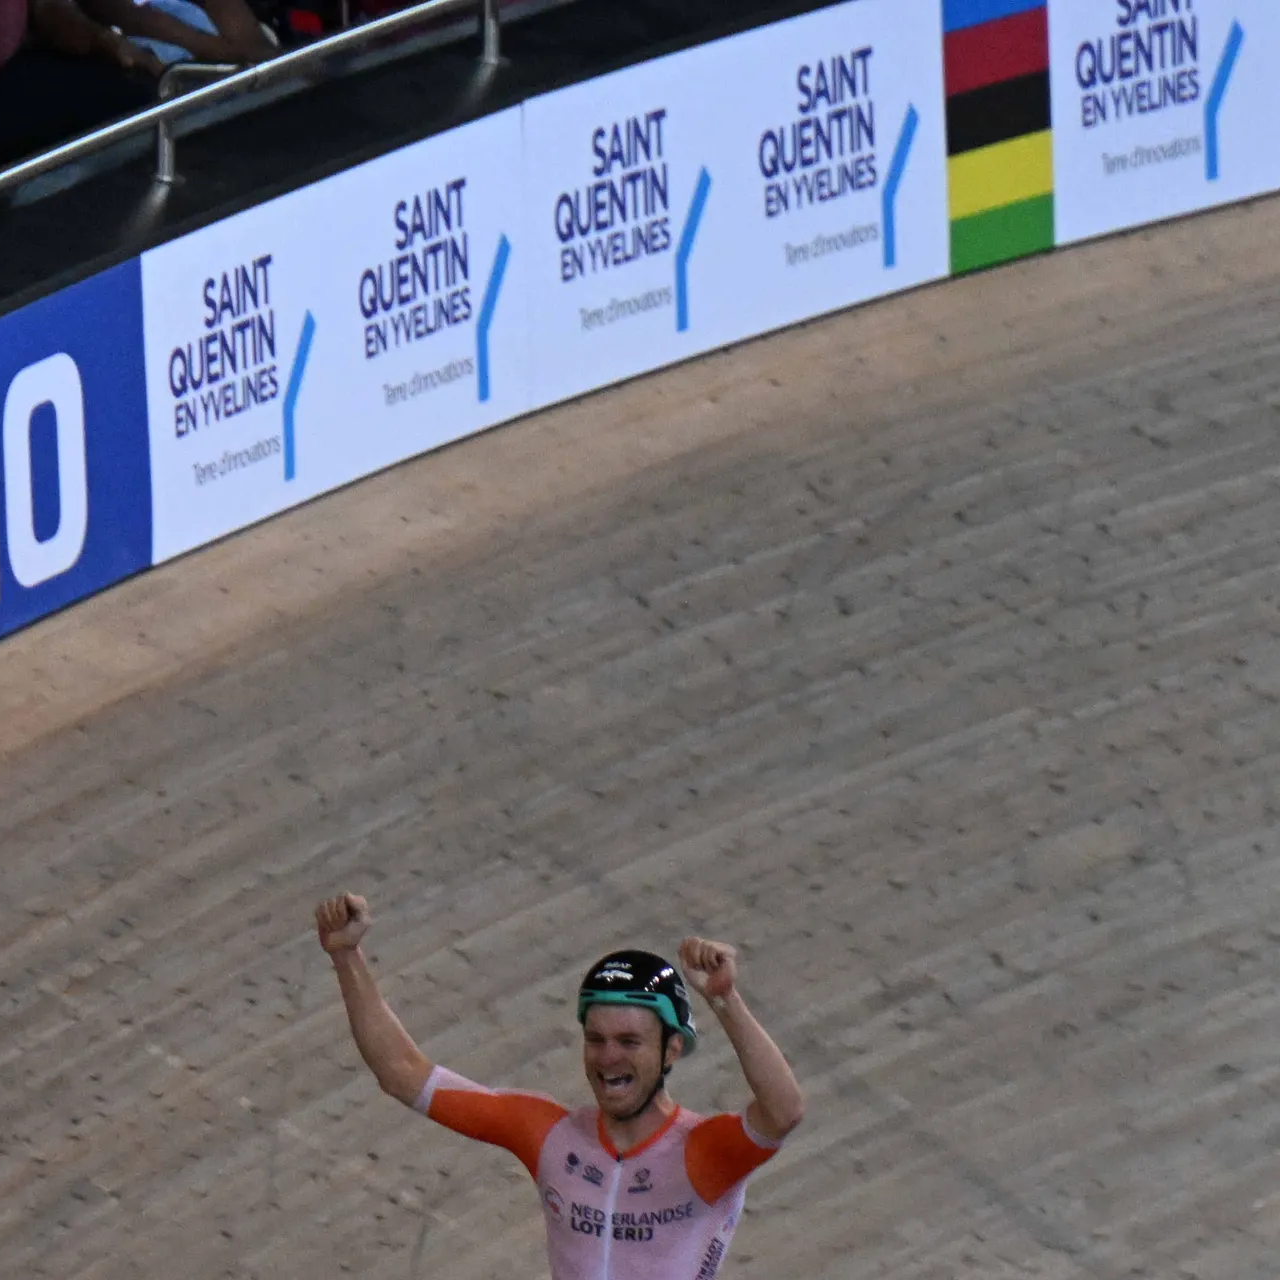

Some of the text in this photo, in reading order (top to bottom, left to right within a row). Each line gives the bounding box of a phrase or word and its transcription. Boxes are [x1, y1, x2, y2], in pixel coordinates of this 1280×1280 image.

[797, 45, 874, 114] SAINT
[1075, 15, 1198, 89] QUENTIN
[1081, 69, 1200, 128] EN YVELINES
[591, 108, 666, 177] SAINT
[759, 100, 876, 178] QUENTIN
[394, 176, 467, 250] SAINT
[555, 163, 669, 243] QUENTIN
[765, 154, 877, 219] EN YVELINES
[359, 231, 469, 319] QUENTIN
[561, 217, 670, 283] EN YVELINES
[203, 254, 272, 329] SAINT
[365, 287, 472, 359] EN YVELINES
[169, 310, 277, 398] QUENTIN
[175, 364, 279, 439] EN YVELINES
[570, 1200, 694, 1226] NEDERLANDSE
